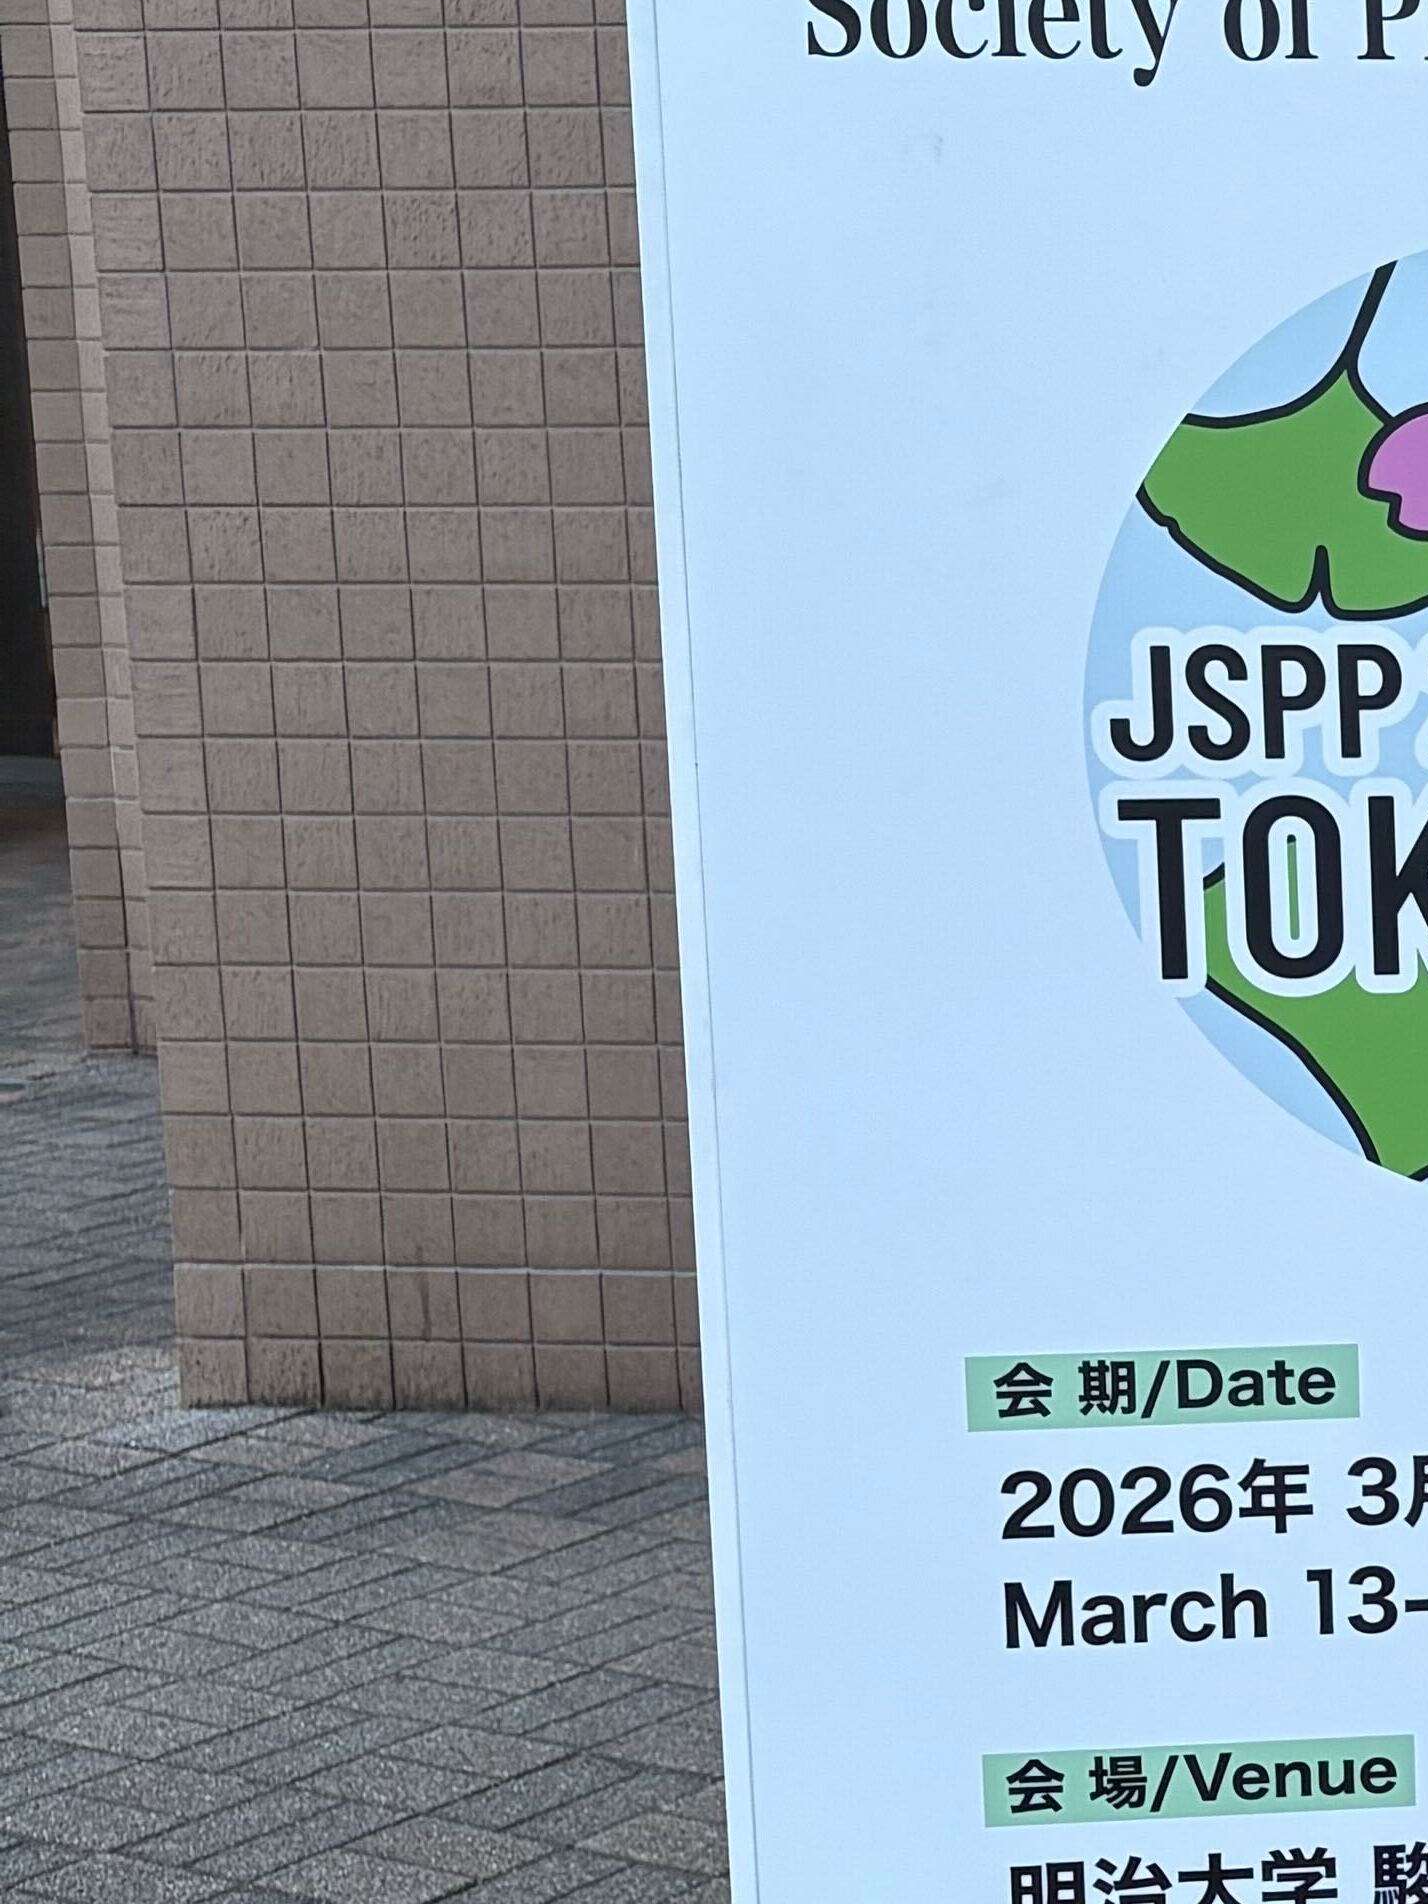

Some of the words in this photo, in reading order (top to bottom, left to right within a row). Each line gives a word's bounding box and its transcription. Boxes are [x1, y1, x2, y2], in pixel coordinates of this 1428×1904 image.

[1110, 643, 1402, 762] JSPP
[1001, 1458, 1314, 1540] 2026年
[1004, 1573, 1269, 1649] March
